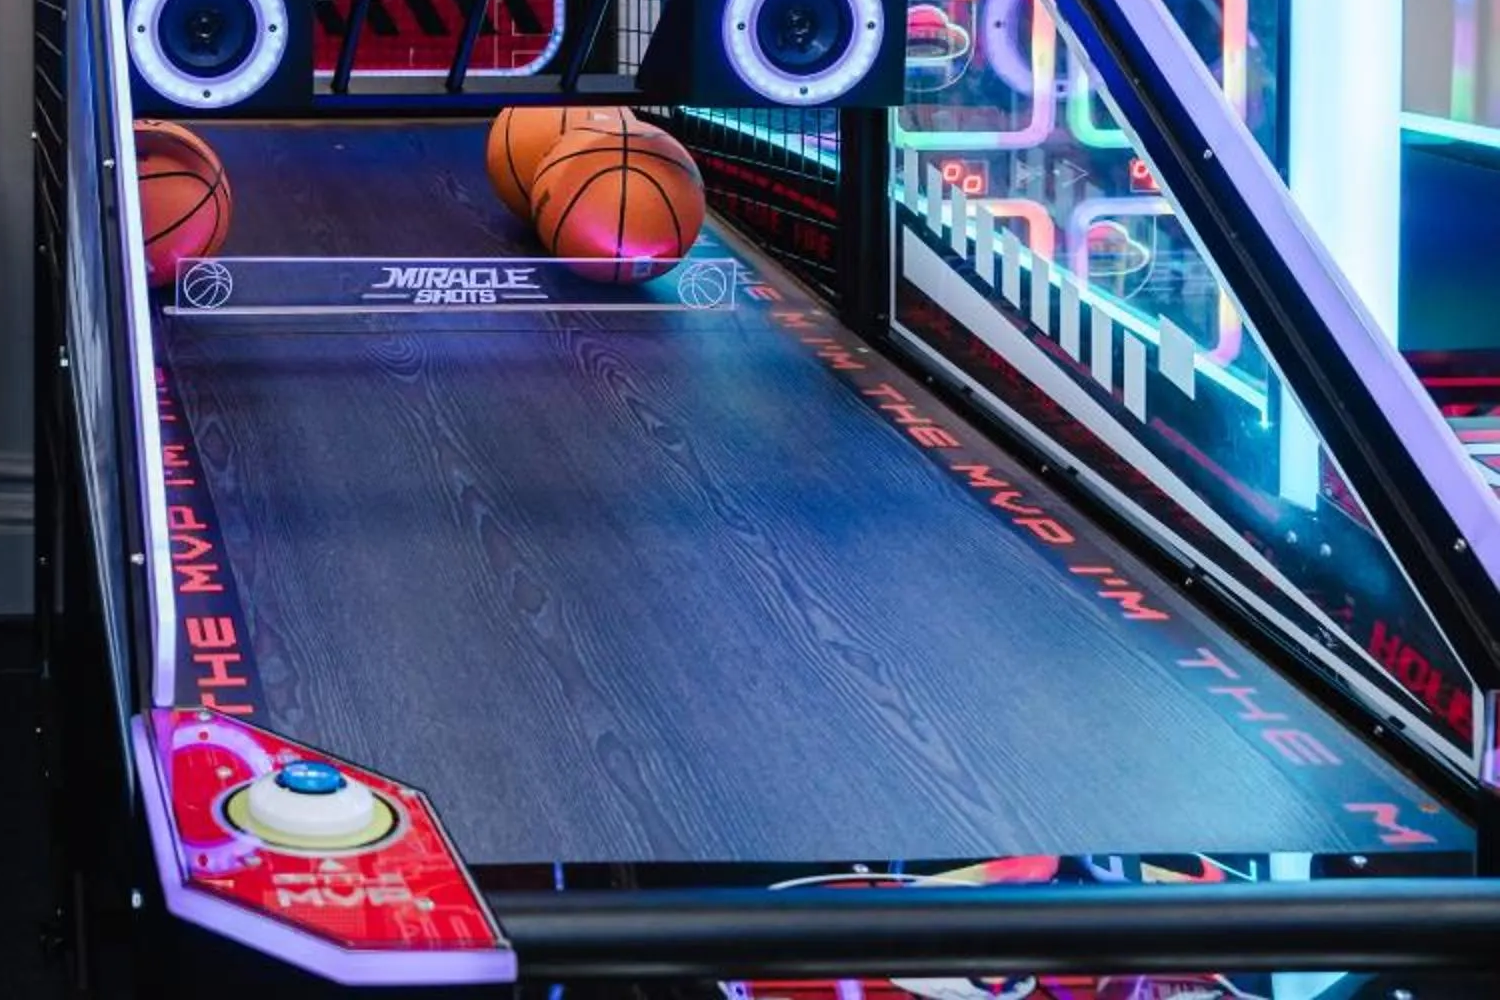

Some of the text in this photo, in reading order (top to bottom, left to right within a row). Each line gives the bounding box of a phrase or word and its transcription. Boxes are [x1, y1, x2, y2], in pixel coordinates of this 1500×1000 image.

[371, 266, 541, 290] MIRACLE
[412, 289, 497, 304] SHOTS
[169, 506, 224, 593] MVP
[801, 335, 867, 370] I'M
[860, 381, 962, 451] THE
[950, 462, 1078, 547] MVP
[1069, 564, 1170, 623] I'M
[1175, 645, 1344, 767] THE
